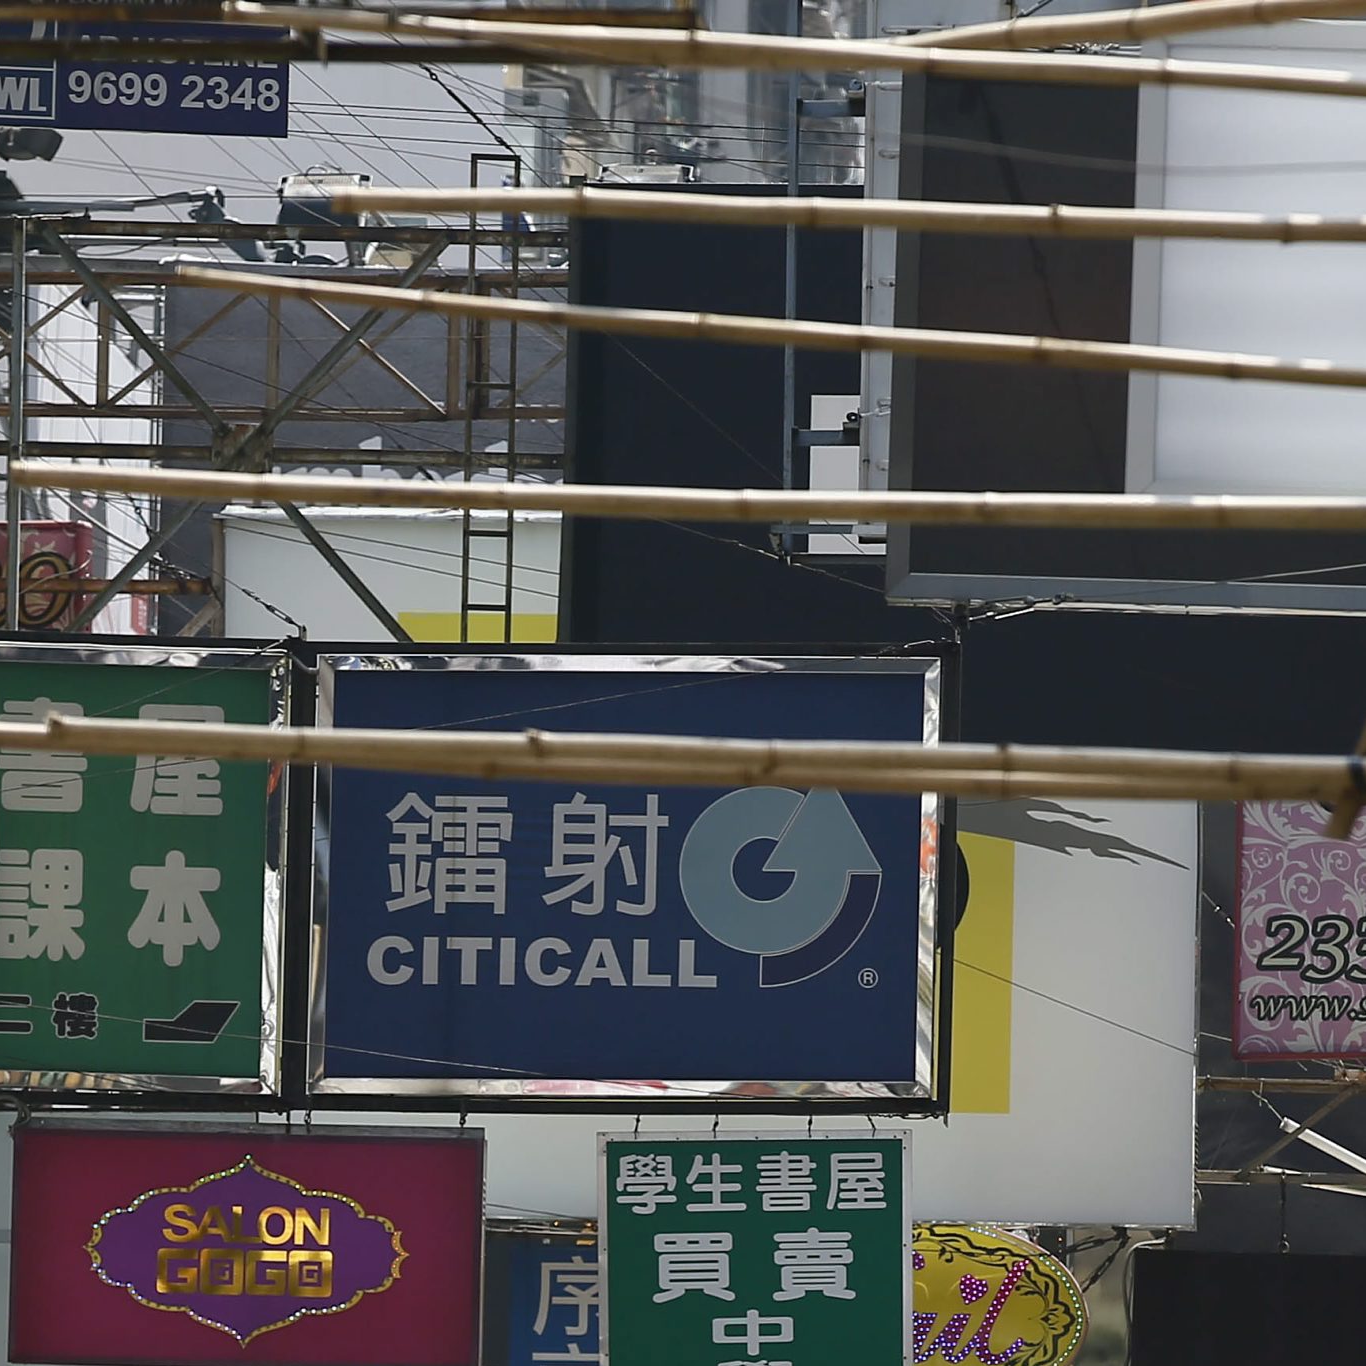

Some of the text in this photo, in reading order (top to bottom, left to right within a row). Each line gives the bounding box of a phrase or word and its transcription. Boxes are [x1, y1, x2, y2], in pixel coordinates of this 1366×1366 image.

[67, 69, 281, 112] 9699 2348
[385, 792, 670, 916] 鐳射
[366, 935, 719, 989] CITICALL
[616, 1150, 887, 1215] 學生書屋
[161, 1203, 332, 1246] SALON
[652, 1227, 857, 1303] 買賣
